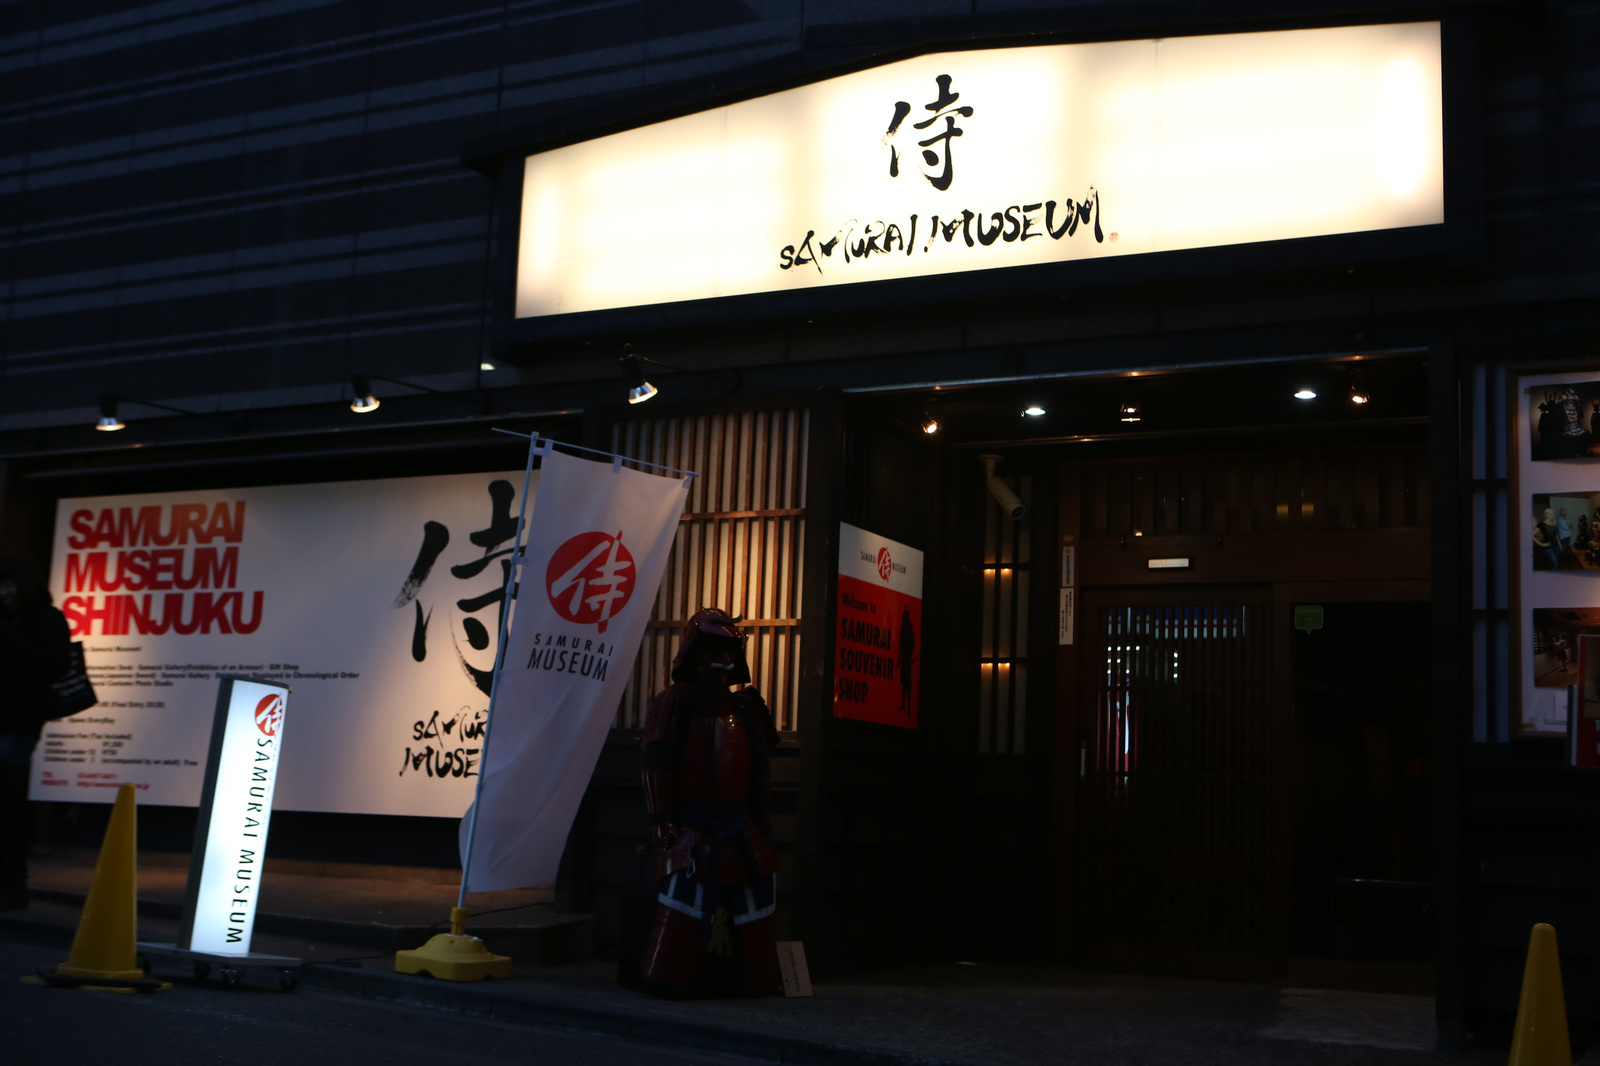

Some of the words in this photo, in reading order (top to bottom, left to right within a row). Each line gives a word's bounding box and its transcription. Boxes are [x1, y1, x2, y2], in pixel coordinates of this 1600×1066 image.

[881, 74, 973, 190] 侍
[68, 501, 246, 549] SAMURAI
[64, 547, 239, 592] MUSEUM
[62, 591, 264, 636] SHINJUKU
[842, 592, 868, 613] Welcome
[870, 602, 876, 614] to
[534, 633, 614, 656] SAMURAI
[841, 617, 892, 650] SAMURAI
[527, 648, 608, 681] MUSEUM
[840, 648, 894, 680] SOUVENIR
[839, 678, 868, 704] SHOP
[244, 738, 273, 838] SAMURAI
[226, 849, 255, 944] MUSEUM
